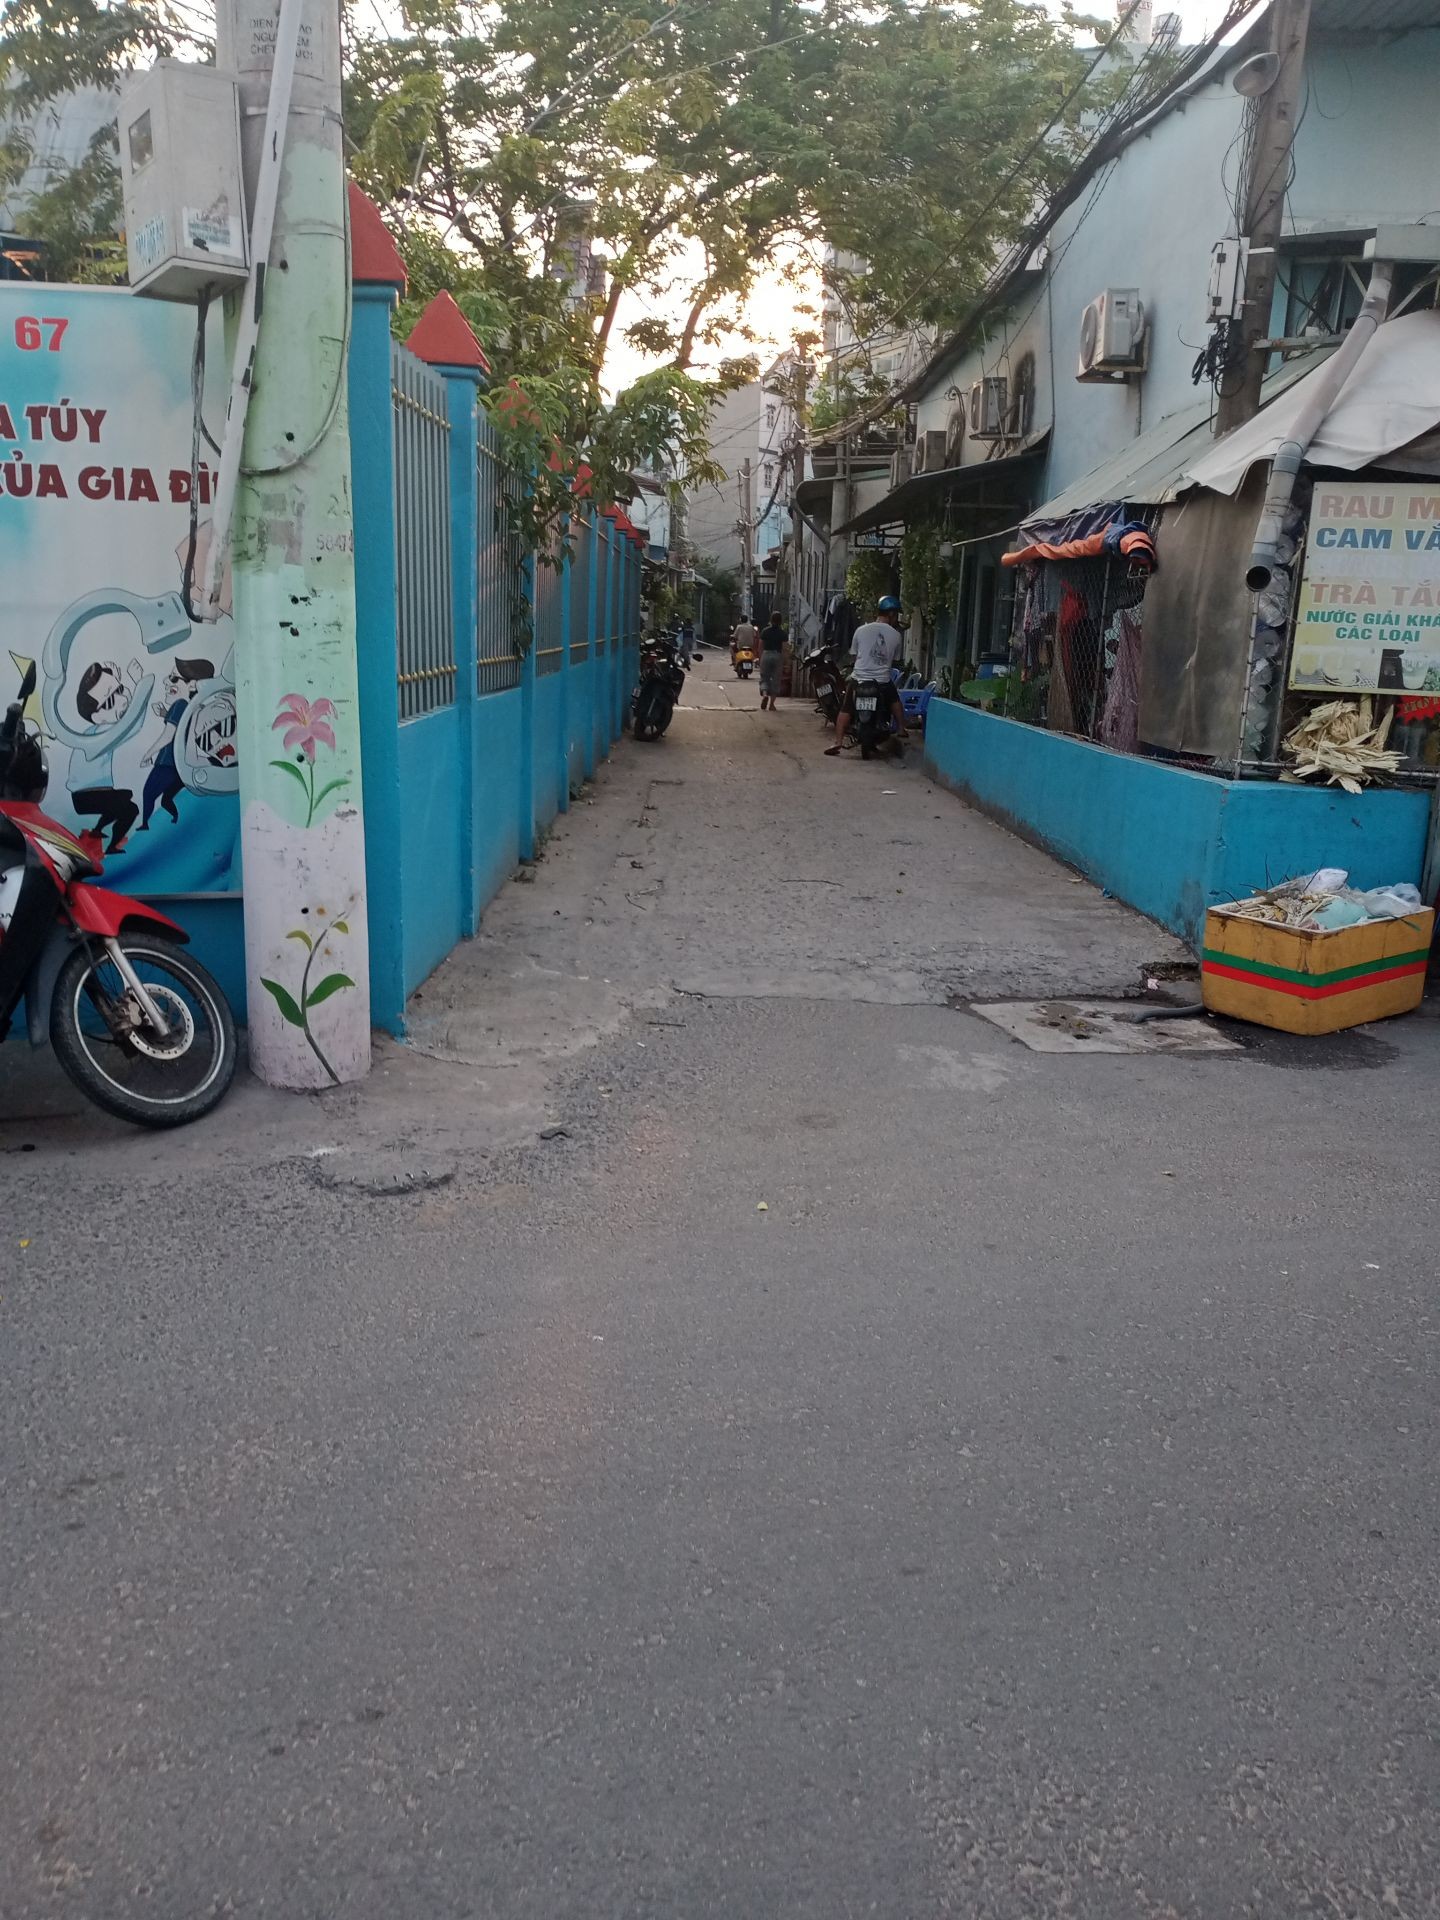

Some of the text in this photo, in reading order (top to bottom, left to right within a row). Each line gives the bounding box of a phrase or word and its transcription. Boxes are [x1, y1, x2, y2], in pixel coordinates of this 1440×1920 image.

[254, 33, 278, 43] NGU
[15, 316, 69, 352] 67
[26, 399, 107, 443] TÚY
[0, 450, 218, 505] ỦA GIA ĐÌ
[1320, 495, 1395, 520] RAU
[1316, 527, 1393, 550] CAM
[1311, 579, 1440, 607] TRÀ TẮ
[1306, 610, 1357, 625] NƯỚC
[1363, 610, 1401, 627] GIẢI
[1336, 626, 1421, 645] CÁC LOẠI
